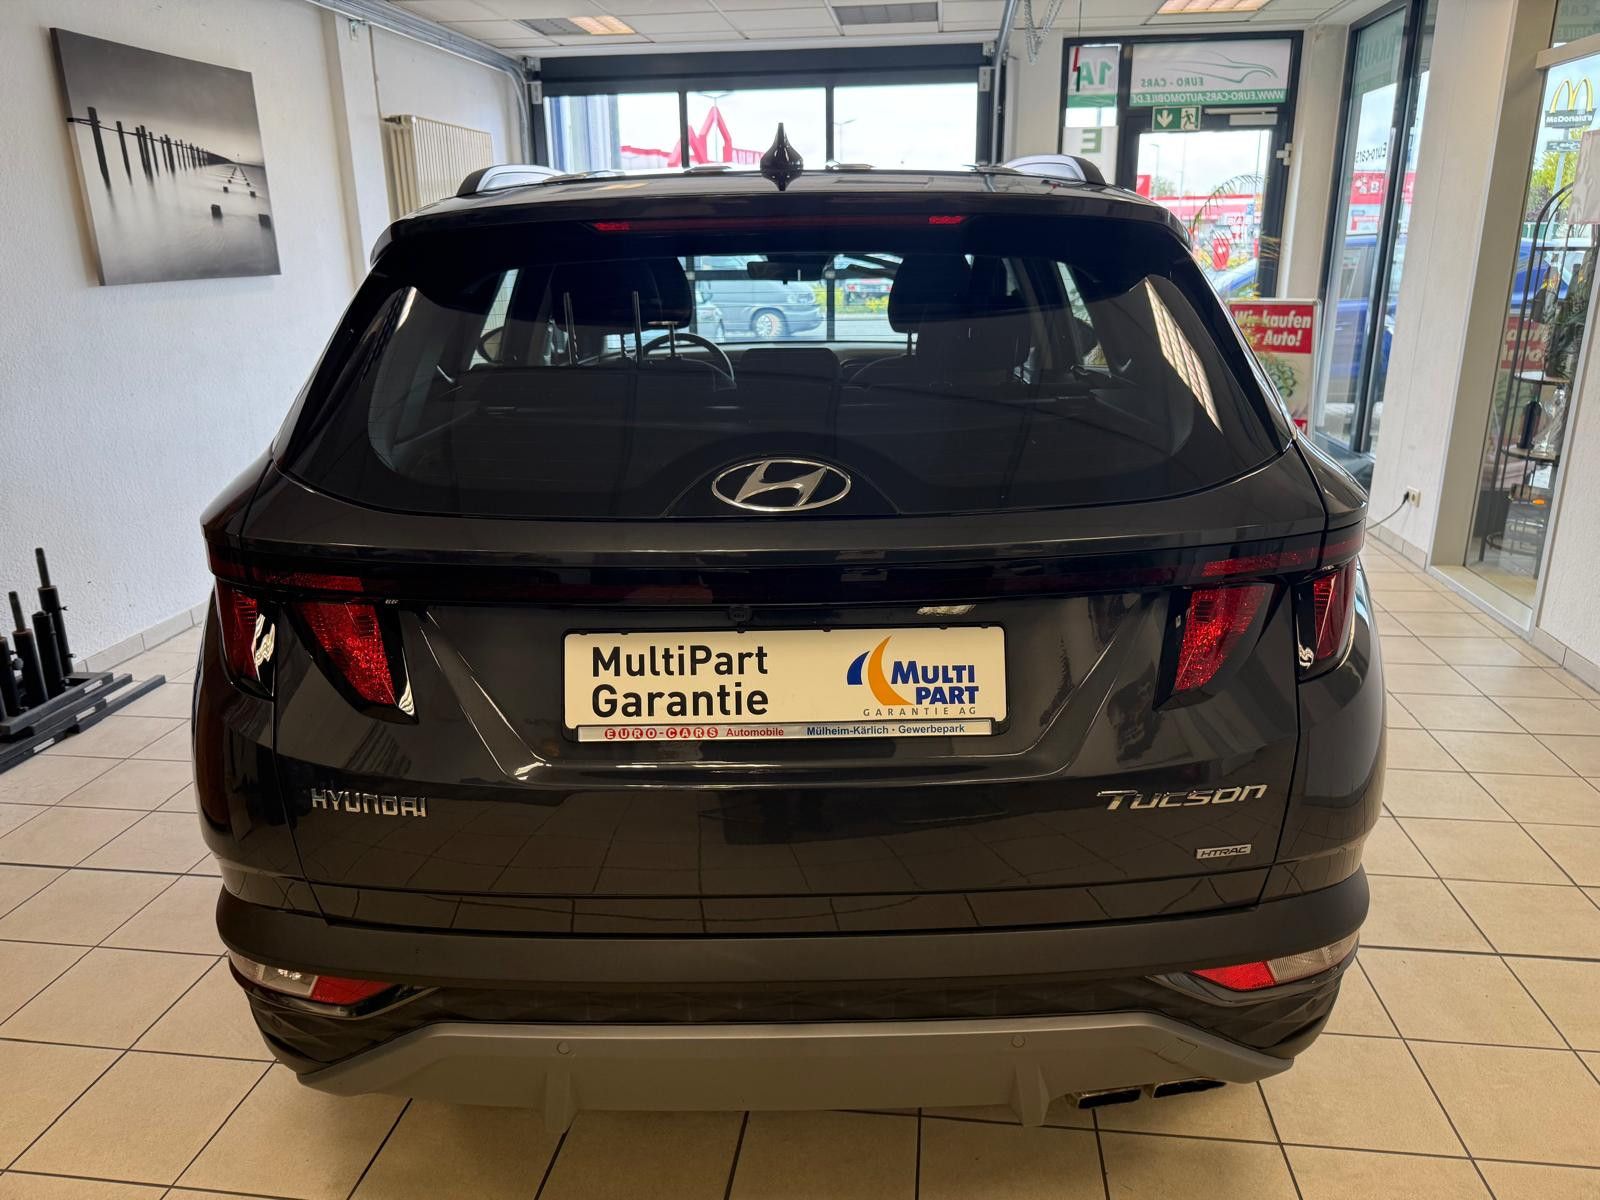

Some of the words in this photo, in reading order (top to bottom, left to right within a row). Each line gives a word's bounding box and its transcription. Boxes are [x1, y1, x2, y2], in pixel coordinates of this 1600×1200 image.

[1546, 114, 1593, 123] McDonald's
[1262, 309, 1312, 328] kaufen
[1263, 329, 1303, 347] Auto!
[592, 645, 768, 677] MultiPart
[891, 661, 975, 684] MULTI
[592, 682, 769, 718] Garantie
[915, 686, 979, 705] PART
[863, 707, 949, 716] GARANTIE
[959, 706, 976, 715] AG
[605, 727, 719, 740] EURO-CARS
[726, 727, 784, 737] Automobile
[807, 726, 889, 736] Mülheim-Kärlich
[898, 723, 965, 735] Gewerbepark
[311, 788, 426, 817] HYUNDAI
[1200, 846, 1247, 857] HTRAC
